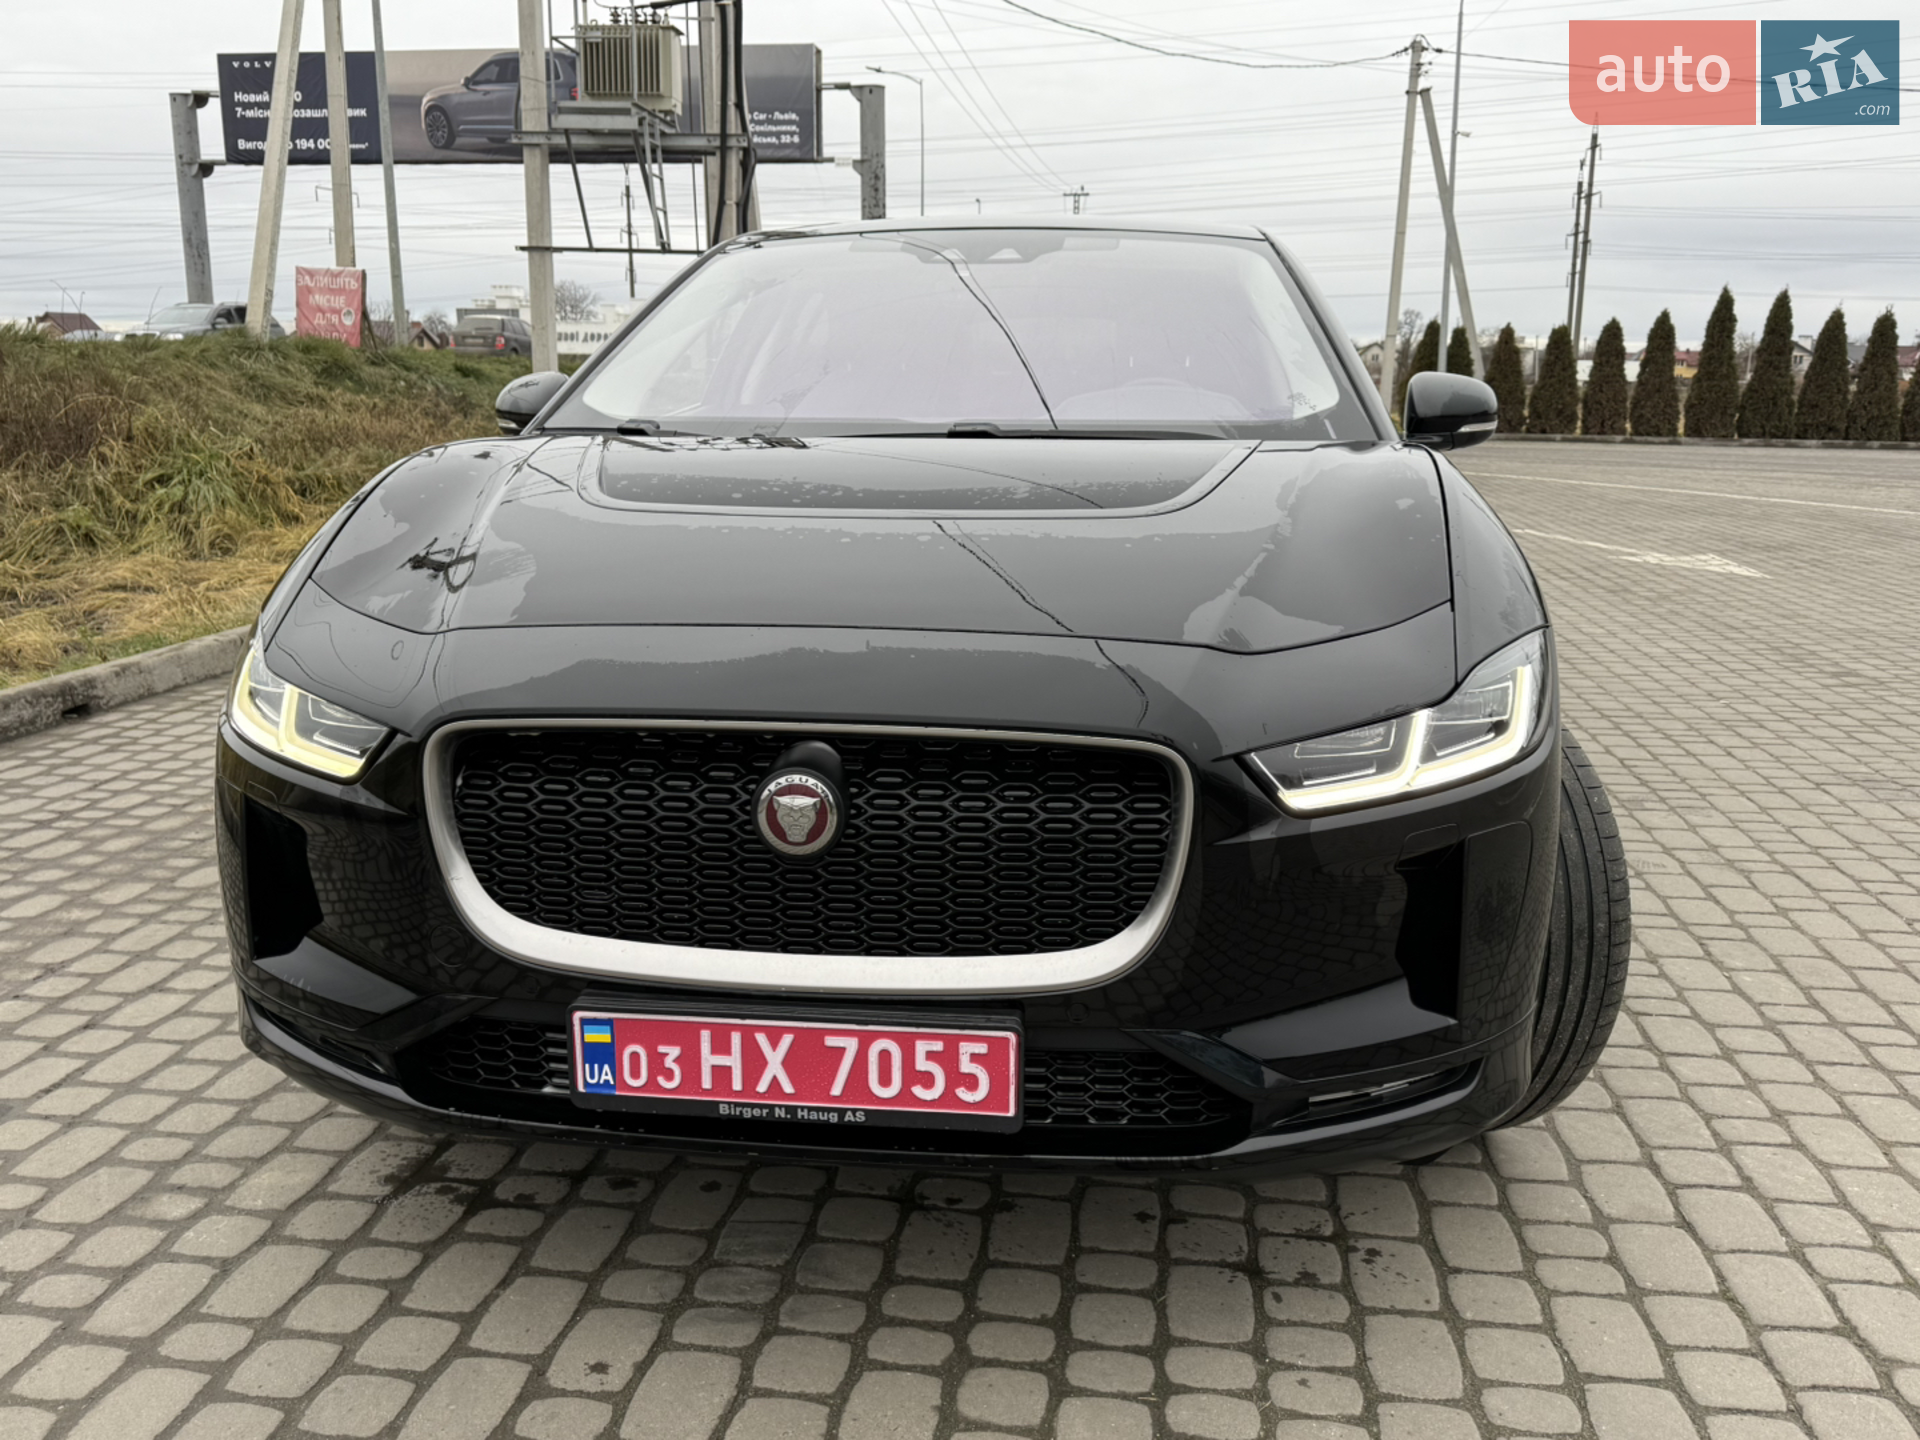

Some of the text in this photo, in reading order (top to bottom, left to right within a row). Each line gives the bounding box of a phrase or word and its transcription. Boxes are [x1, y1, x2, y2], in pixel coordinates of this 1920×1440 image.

[232, 61, 272, 69] VOLV
[234, 91, 270, 102] Новий
[295, 138, 315, 150] 194
[296, 274, 359, 290] ЗАЛИШІТЬ
[308, 294, 347, 309] МІСЦЕ
[313, 312, 340, 325] ДЛЯ
[767, 776, 830, 800] JAGUAR
[622, 1029, 991, 1104] 03 HX 7055
[584, 1063, 614, 1086] UA
[718, 1103, 866, 1123] Birger N. Haug AS
